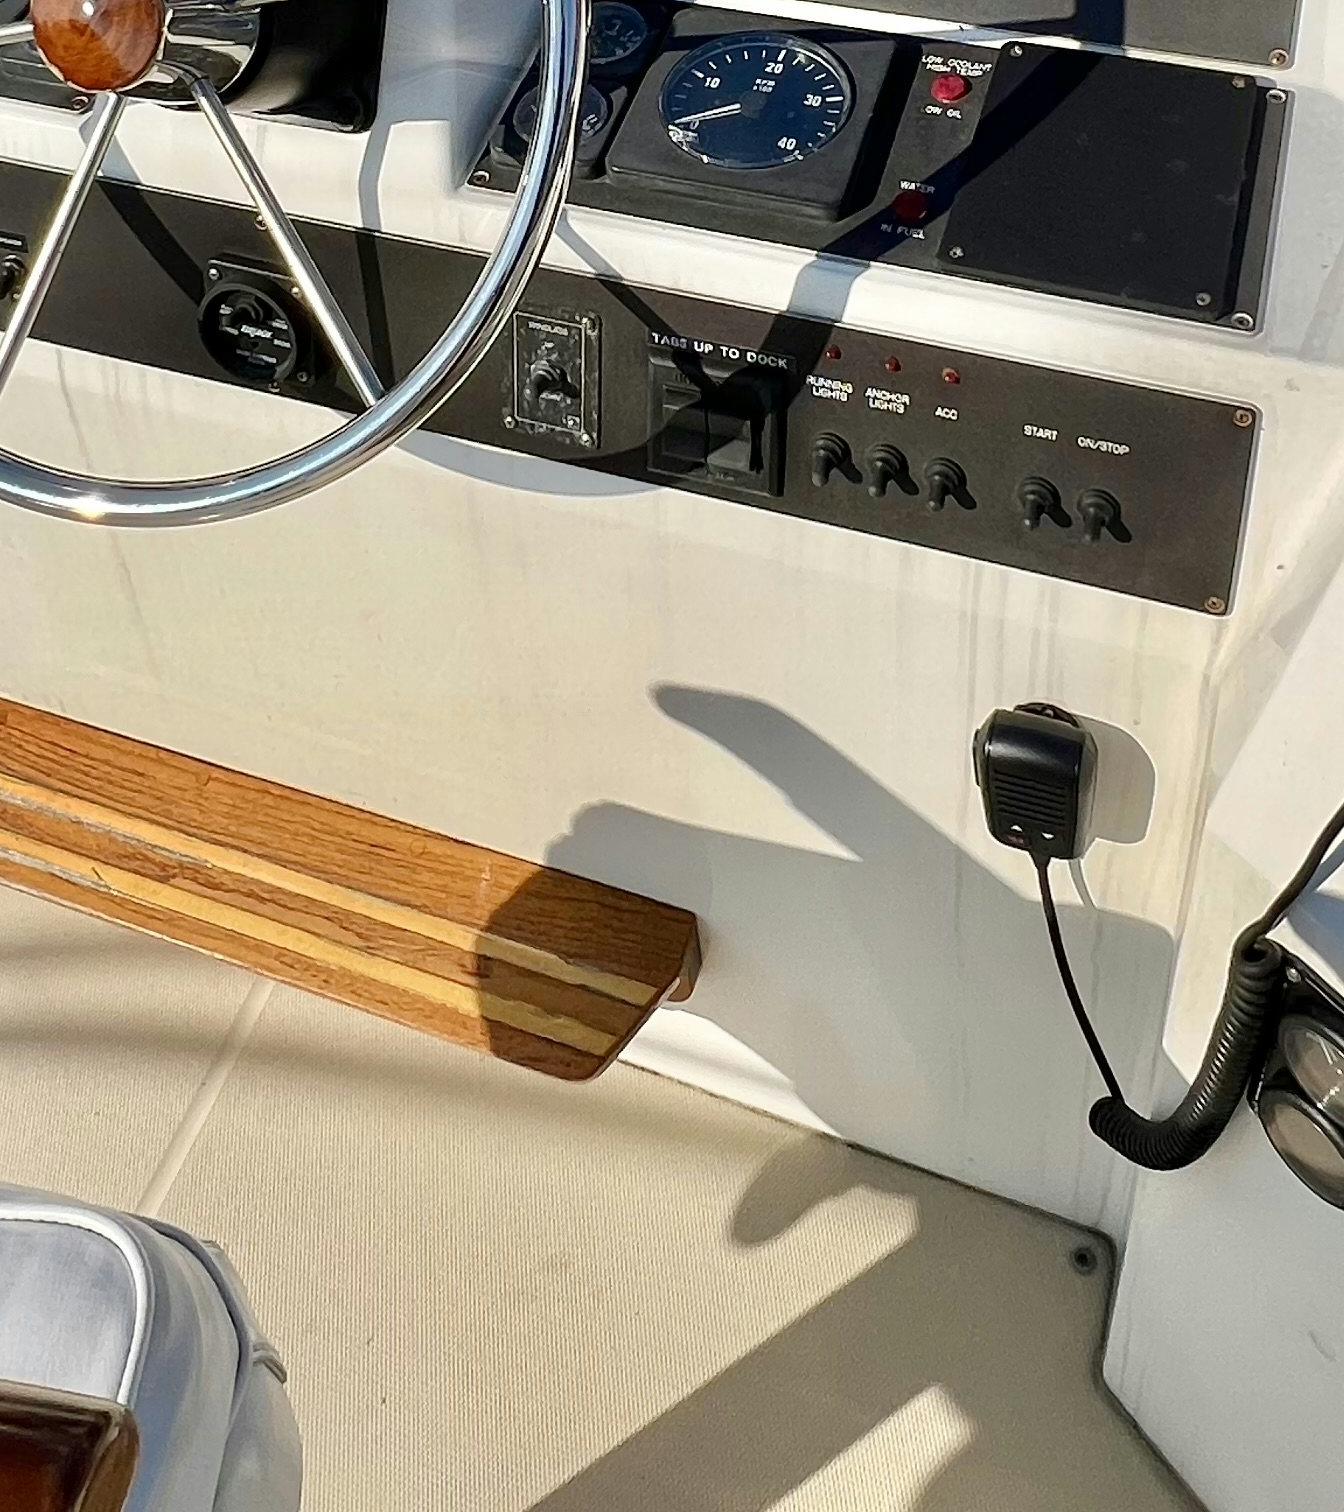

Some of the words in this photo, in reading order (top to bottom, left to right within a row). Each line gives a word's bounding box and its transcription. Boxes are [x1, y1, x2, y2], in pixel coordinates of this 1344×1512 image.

[764, 62, 784, 74] 20
[705, 76, 721, 88] 10
[803, 93, 823, 107] 30
[921, 105, 943, 118] OW
[777, 136, 797, 150] 40
[899, 180, 936, 194] WATER
[896, 225, 926, 240] FUEL
[651, 331, 688, 349] TABS
[693, 340, 714, 354] UP
[719, 345, 740, 359] TO
[746, 351, 788, 369] DOCK
[806, 374, 854, 394] RUNNING
[812, 386, 848, 402] LIGHTS
[864, 387, 911, 406] ANCHOR
[868, 397, 905, 415] LIGHTS
[934, 406, 958, 421] ACC
[1023, 424, 1059, 441] START
[1076, 435, 1131, 456] ON/STOP
